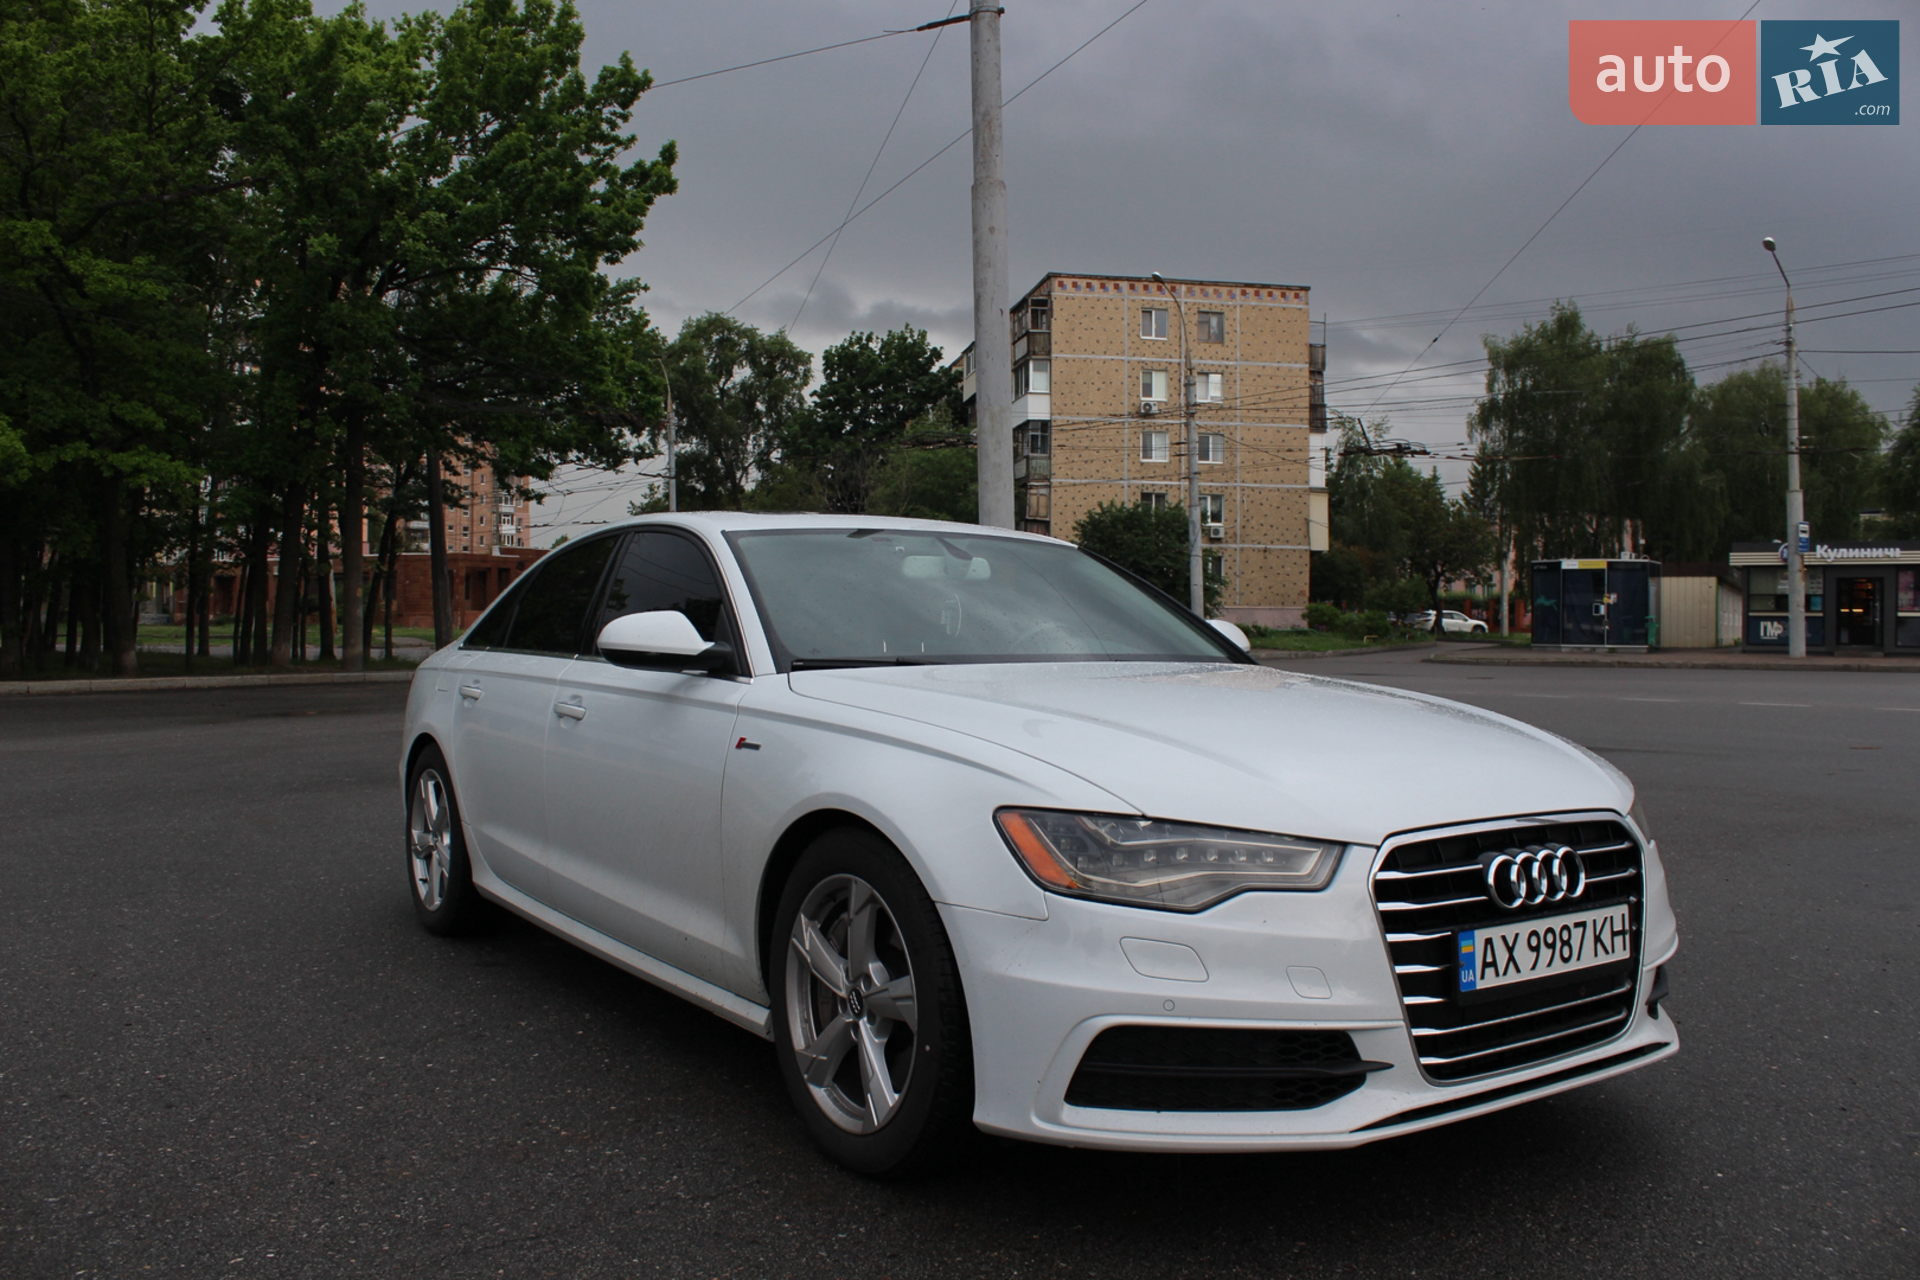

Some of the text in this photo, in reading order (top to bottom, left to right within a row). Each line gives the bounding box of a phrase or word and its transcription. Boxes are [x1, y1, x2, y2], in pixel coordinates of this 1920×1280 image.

[1479, 913, 1628, 980] AX 9987 KH
[1461, 968, 1475, 983] UA
